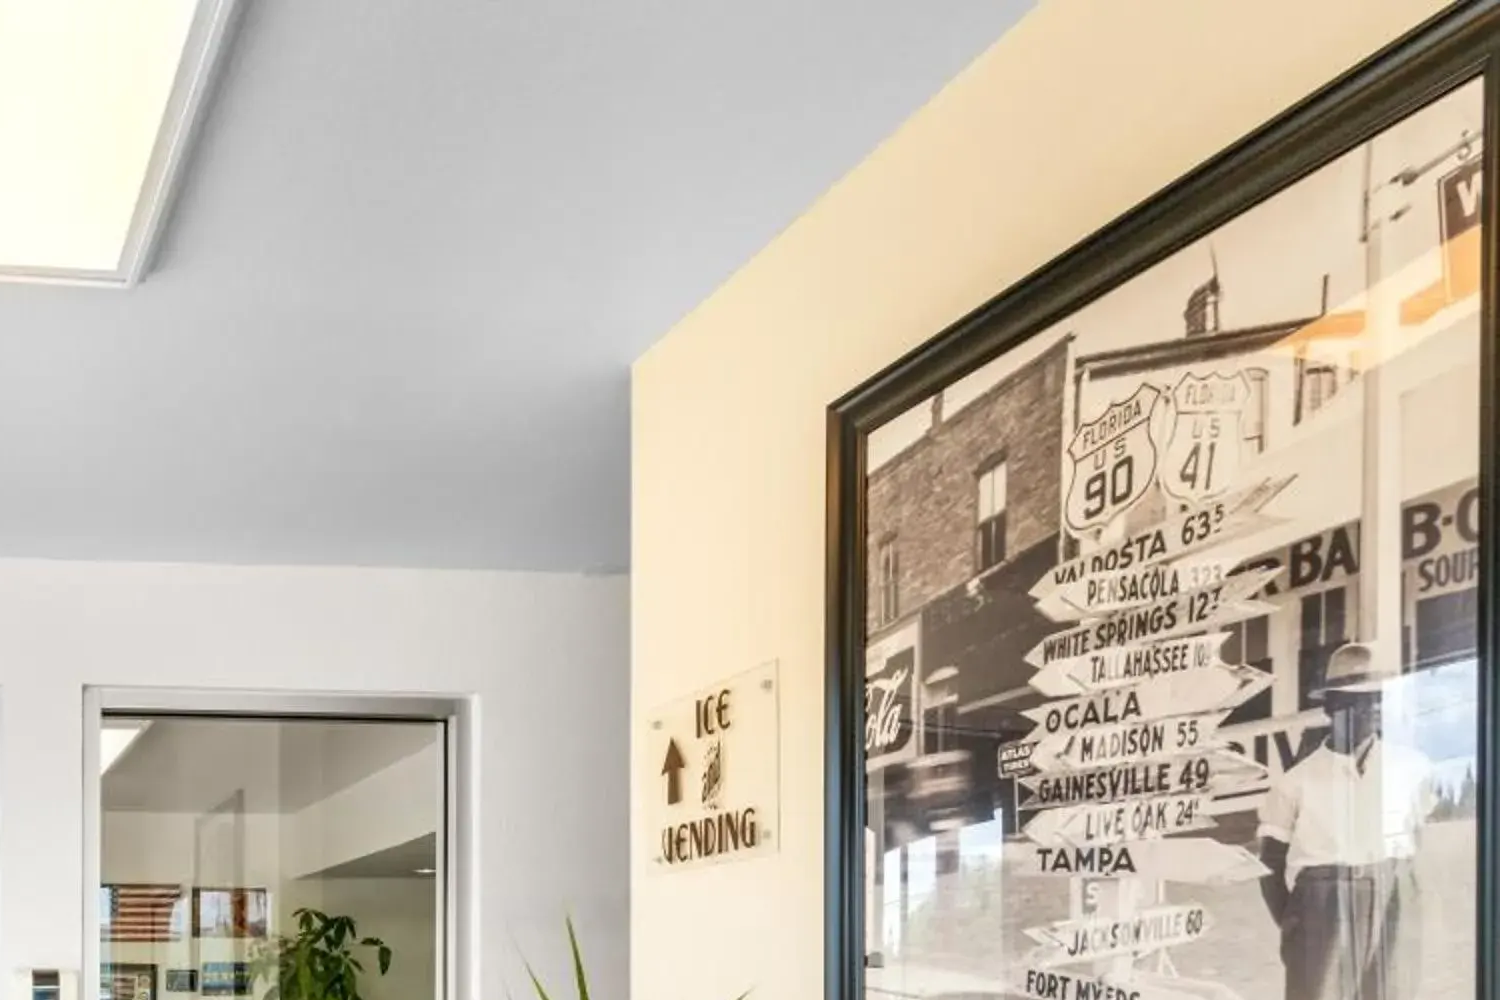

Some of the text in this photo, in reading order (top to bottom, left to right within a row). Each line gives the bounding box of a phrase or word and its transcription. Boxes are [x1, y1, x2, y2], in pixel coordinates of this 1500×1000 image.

[1083, 400, 1142, 450] FLORIDA
[1084, 455, 1135, 521] 90
[1180, 441, 1216, 491] 41
[1087, 569, 1180, 608] PENSACOLA
[1043, 629, 1091, 665] WHITE
[1094, 601, 1178, 650] SPRINGS
[695, 689, 731, 739] ICE
[1045, 691, 1142, 733] OCALA
[1080, 720, 1199, 763] MADISON 55
[1038, 758, 1209, 802] GAINESVILLE 49
[662, 807, 757, 865] VENDING
[1085, 808, 1125, 840] LIVE
[1132, 801, 1167, 835] OAK
[1037, 847, 1136, 875] TAMPA
[1026, 969, 1071, 1000] FORT
